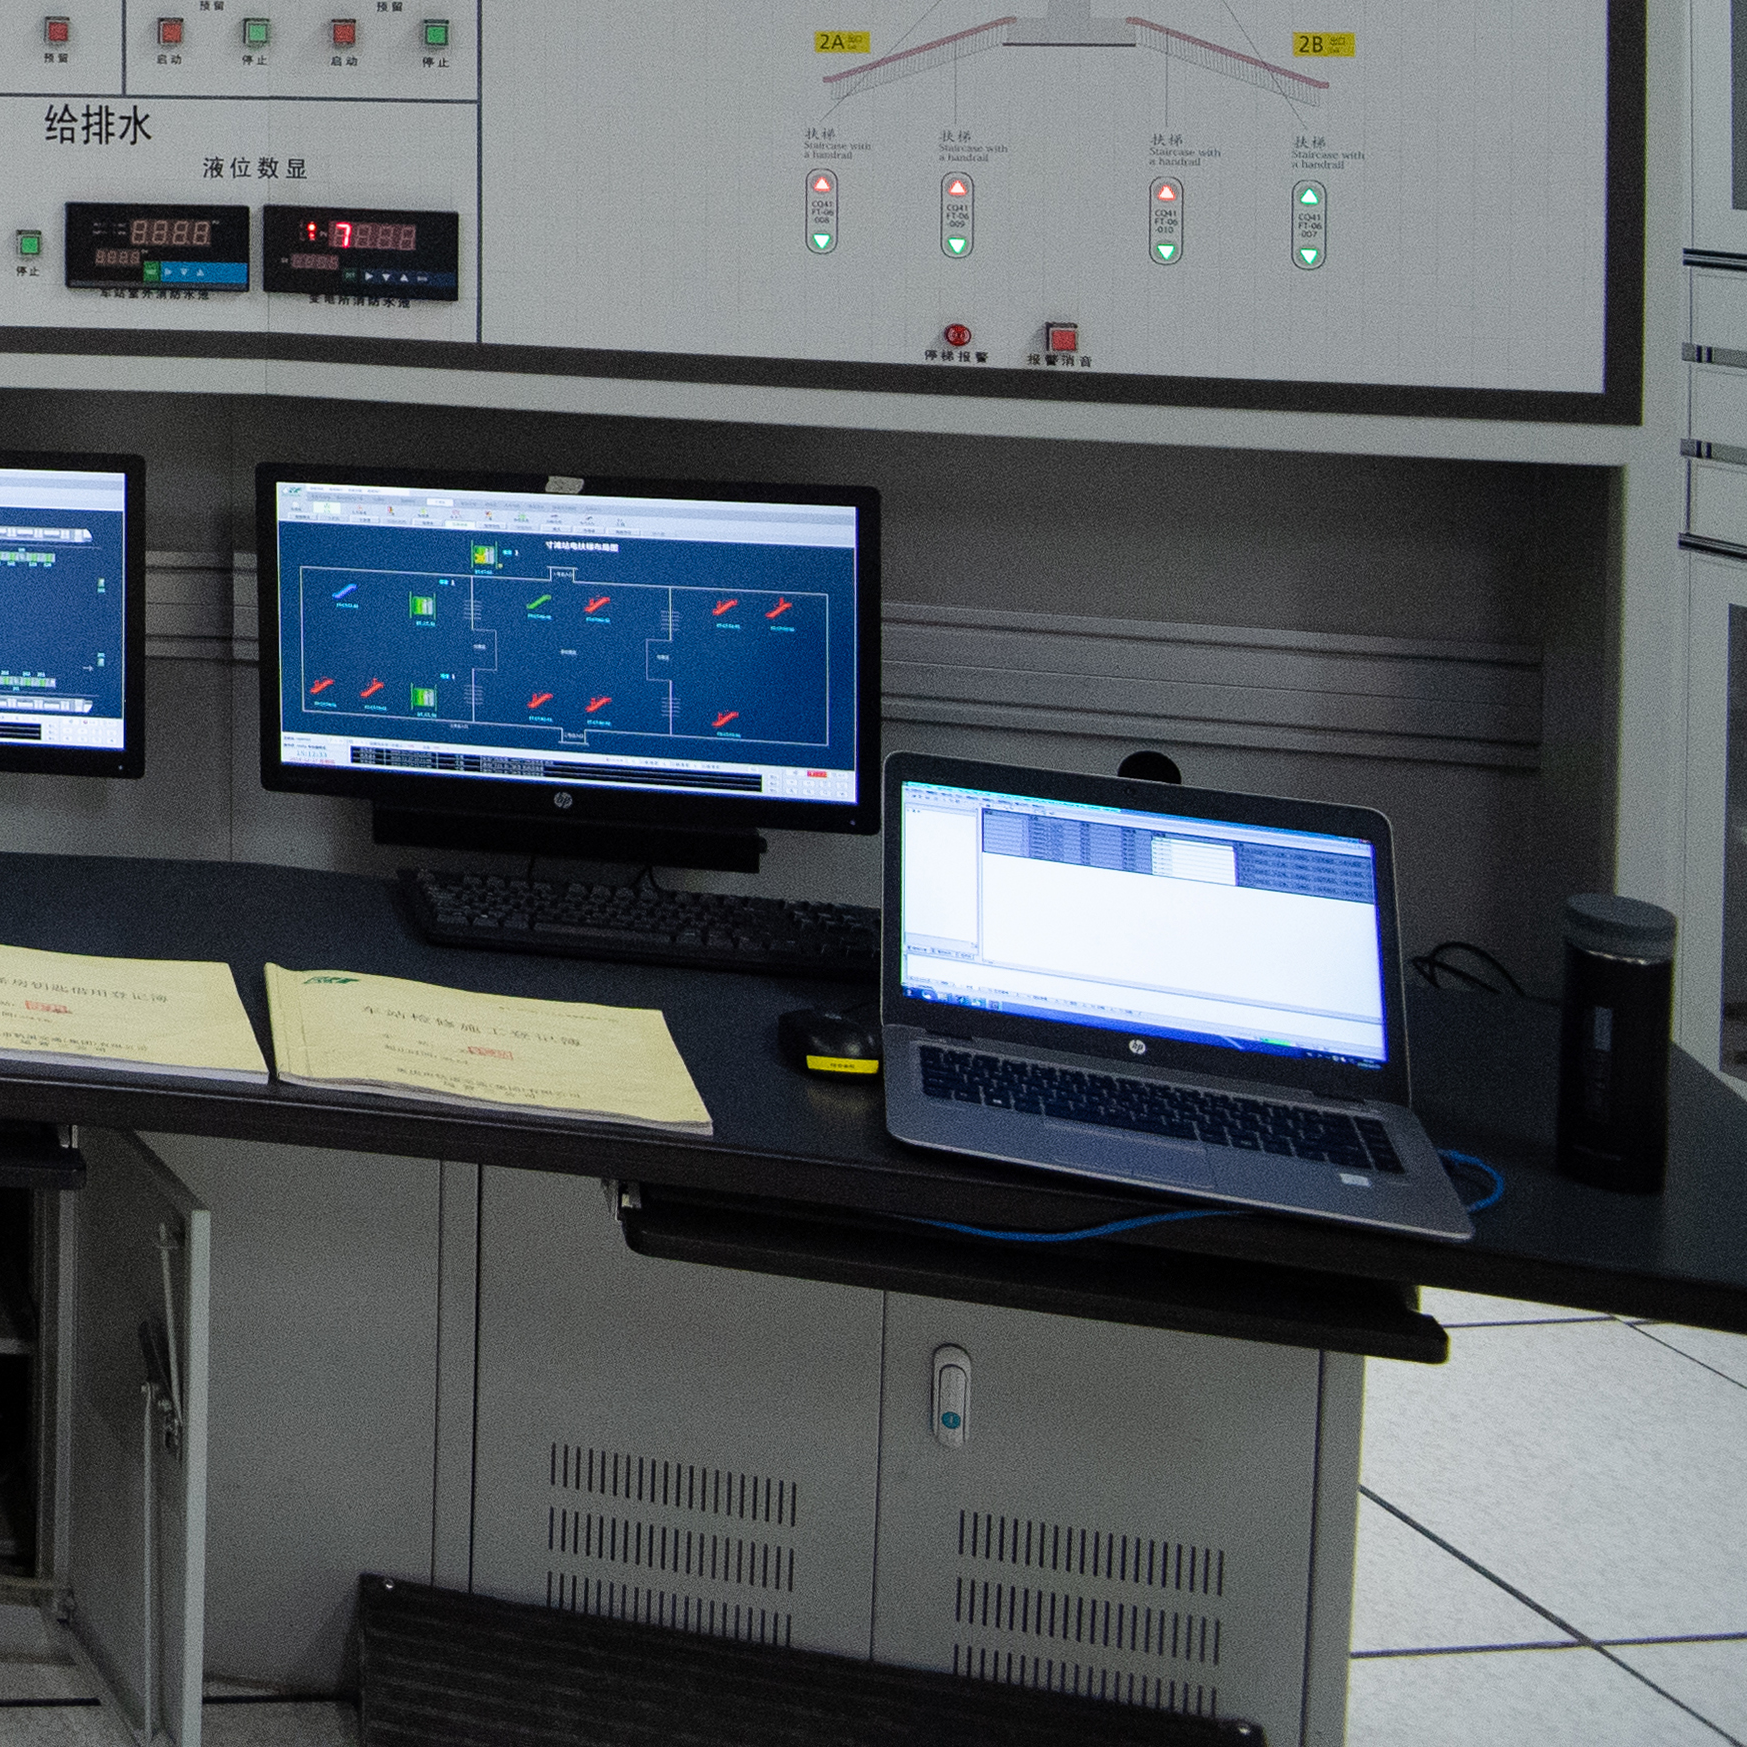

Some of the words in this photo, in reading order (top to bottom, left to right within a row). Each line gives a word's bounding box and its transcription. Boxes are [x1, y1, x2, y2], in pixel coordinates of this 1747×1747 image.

[819, 34, 844, 50] 2A
[1299, 36, 1323, 53] 2B
[44, 104, 152, 146] 给排水
[203, 157, 308, 180] 液位数显
